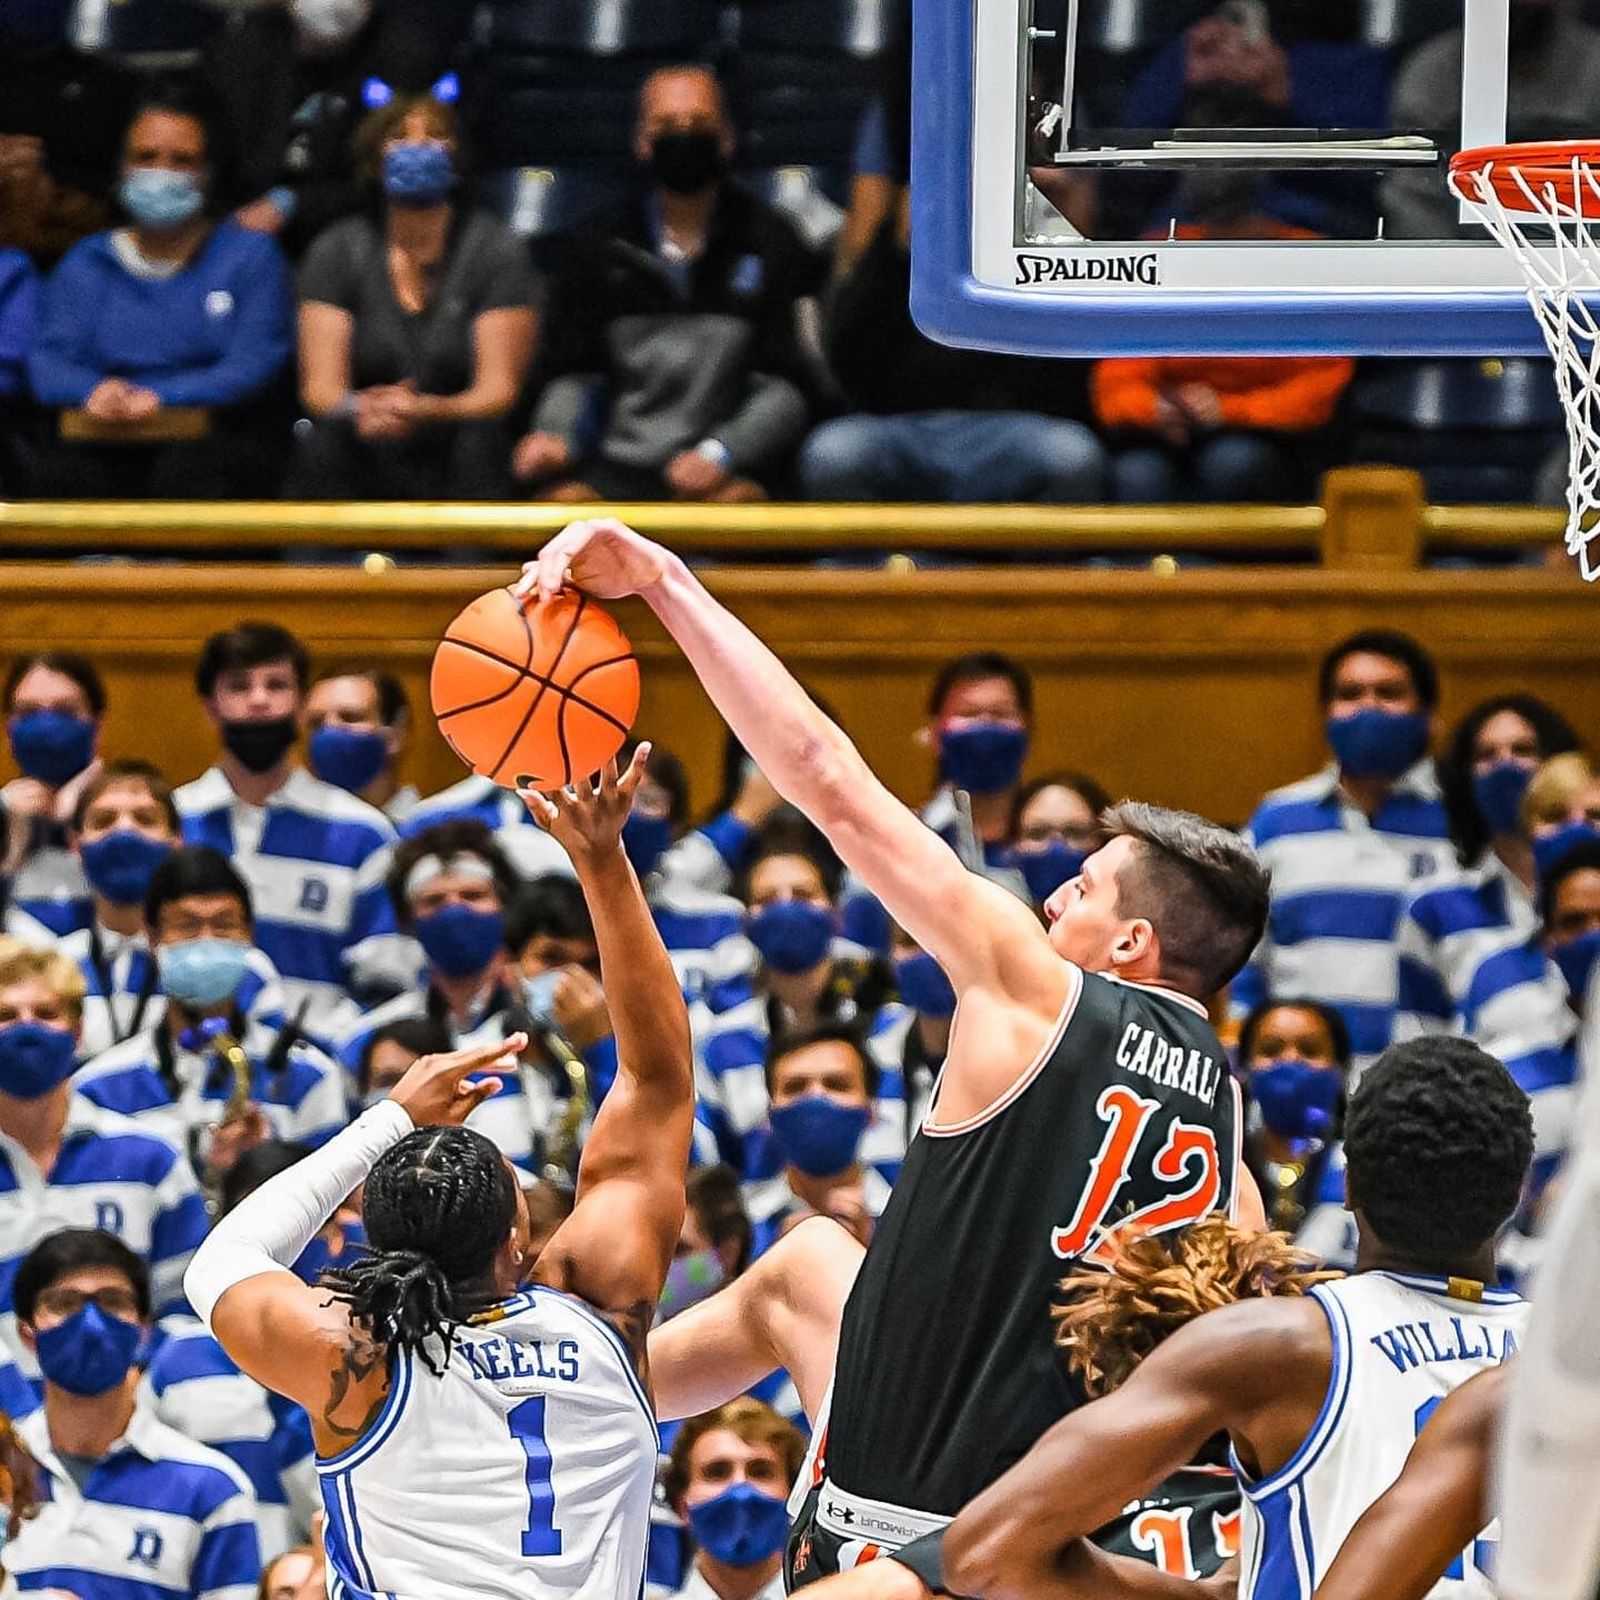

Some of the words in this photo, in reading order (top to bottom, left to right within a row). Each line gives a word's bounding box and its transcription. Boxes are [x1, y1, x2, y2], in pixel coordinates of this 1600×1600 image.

[1016, 254, 1158, 285] SPALDING
[454, 1340, 578, 1381] KEELS
[507, 1395, 562, 1556] 1
